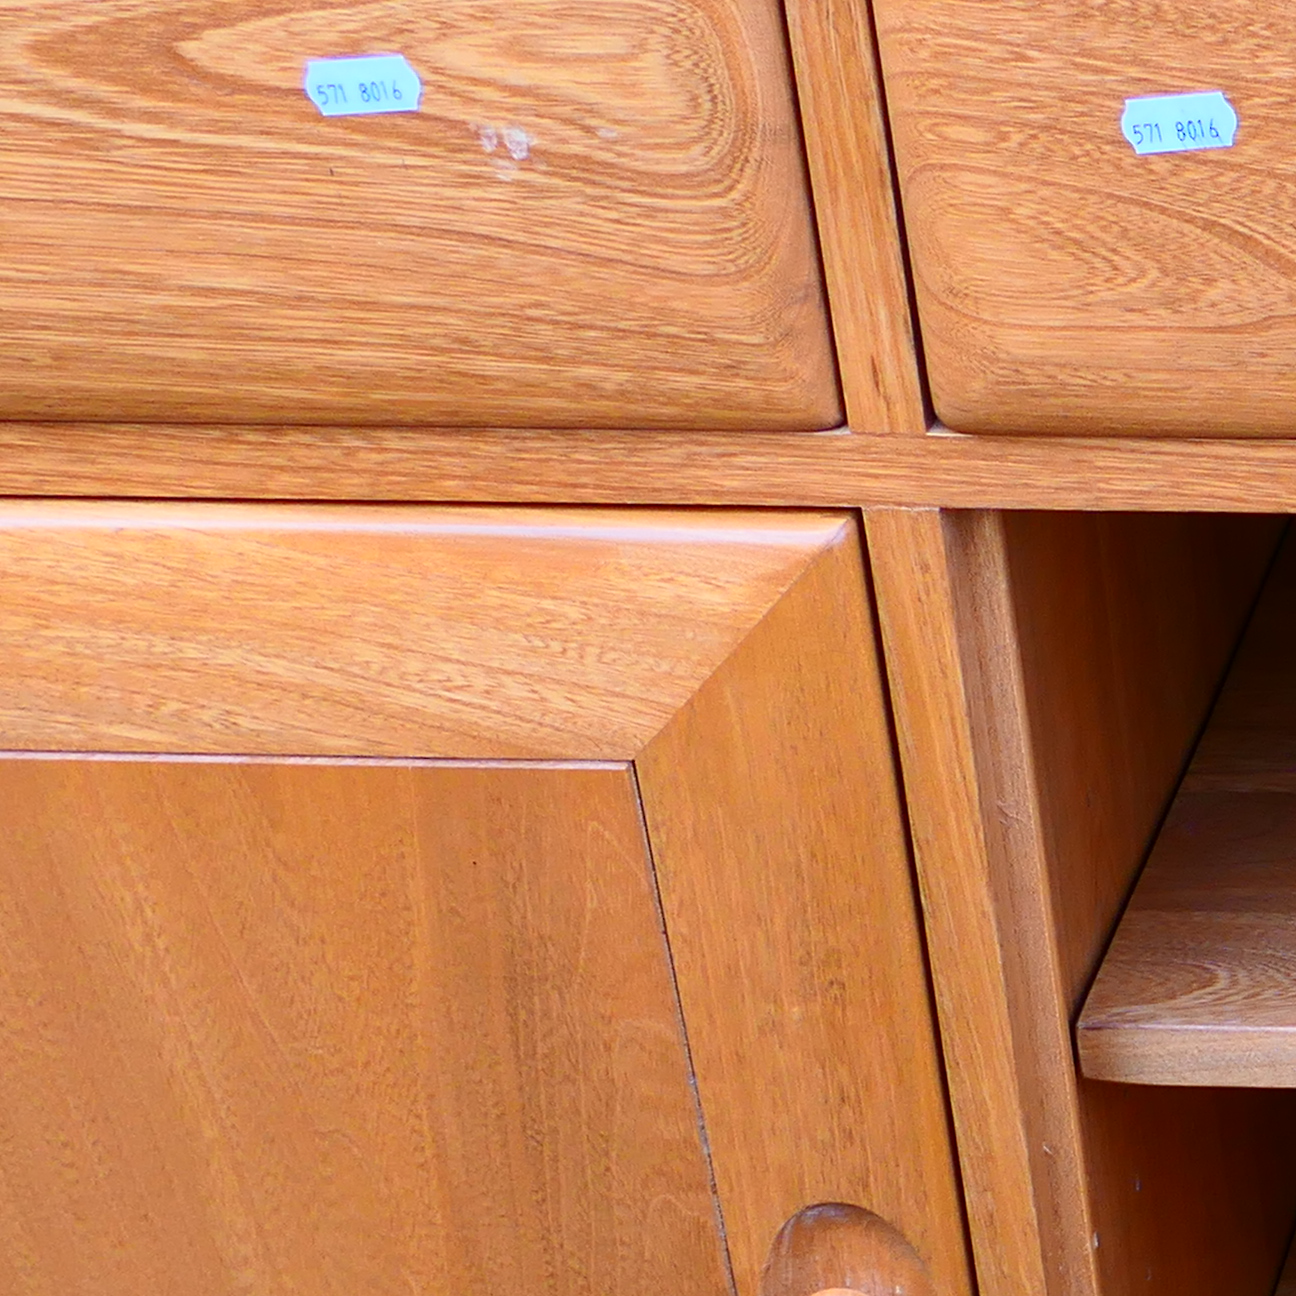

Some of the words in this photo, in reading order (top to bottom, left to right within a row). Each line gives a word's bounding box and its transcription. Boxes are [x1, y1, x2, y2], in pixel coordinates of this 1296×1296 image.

[317, 83, 347, 105] 571
[359, 80, 402, 103] 8016
[1133, 123, 1162, 145] 571
[1175, 118, 1219, 142] 8016
